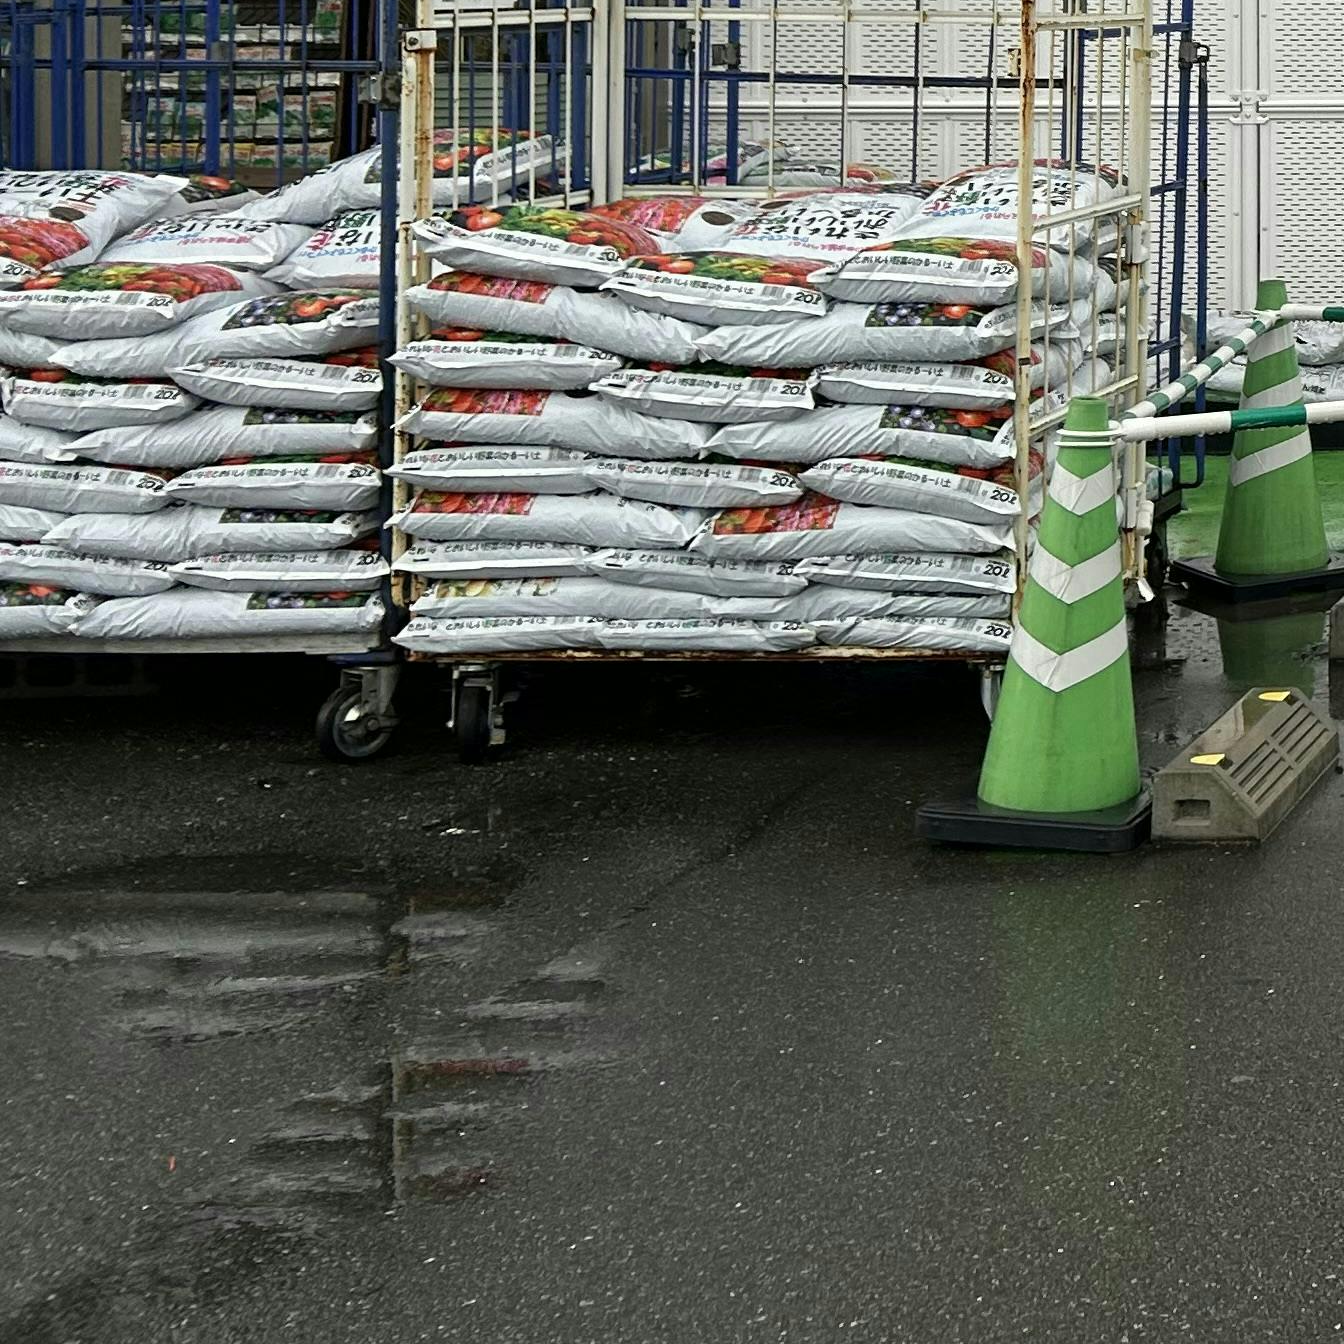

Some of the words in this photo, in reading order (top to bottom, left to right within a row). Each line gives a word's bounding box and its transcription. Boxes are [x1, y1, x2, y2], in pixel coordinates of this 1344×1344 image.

[990, 489, 1018, 505] 20ℓ
[983, 564, 1010, 579] 20ℓ
[983, 625, 1012, 640] 20ℓ
